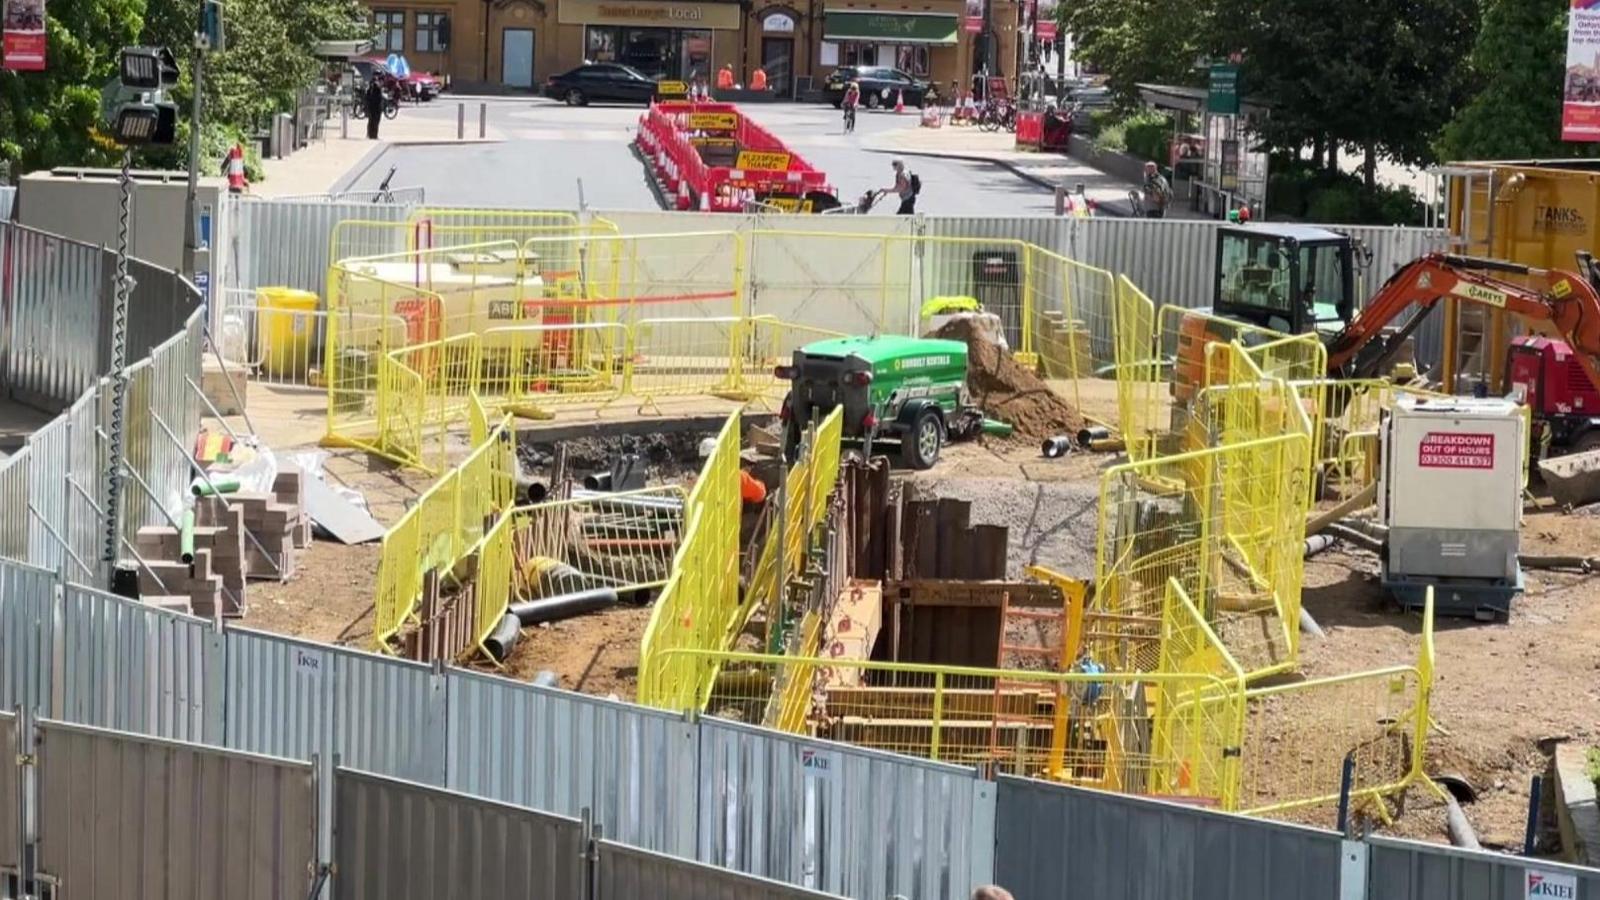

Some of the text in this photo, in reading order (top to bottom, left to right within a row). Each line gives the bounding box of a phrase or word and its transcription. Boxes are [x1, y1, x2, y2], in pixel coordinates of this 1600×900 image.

[668, 6, 702, 20] Local
[1468, 285, 1504, 303] CAREYS
[926, 354, 950, 366] RENTALS
[1422, 445, 1491, 455] OUT OF HOURS
